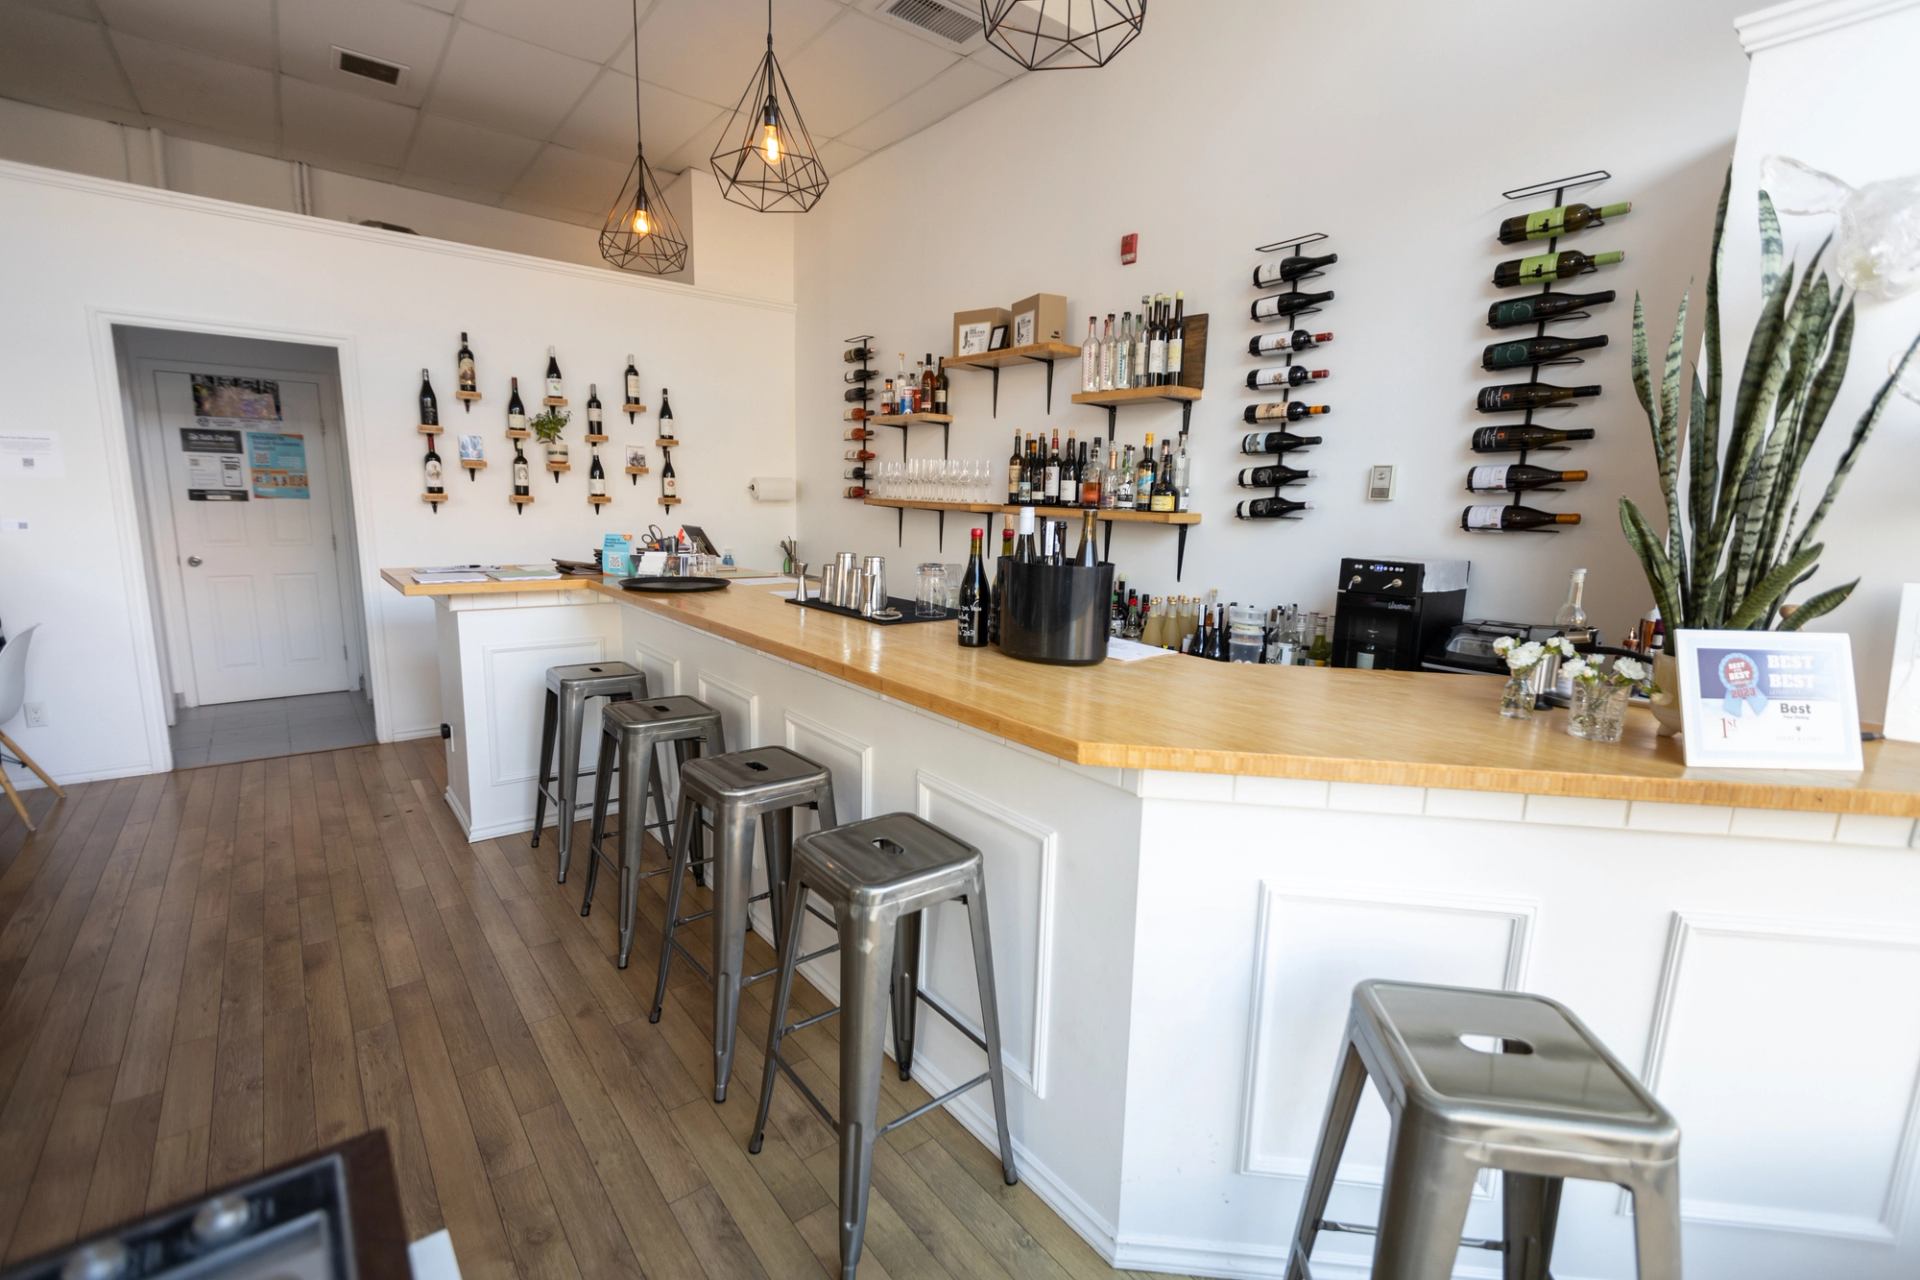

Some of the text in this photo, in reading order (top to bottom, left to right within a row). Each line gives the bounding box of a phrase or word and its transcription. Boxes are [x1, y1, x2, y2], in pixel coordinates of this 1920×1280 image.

[1767, 655, 1813, 669] BEST
[1728, 671, 1751, 681] BEST
[1769, 673, 1815, 688] BEST
[1780, 703, 1811, 714] Best
